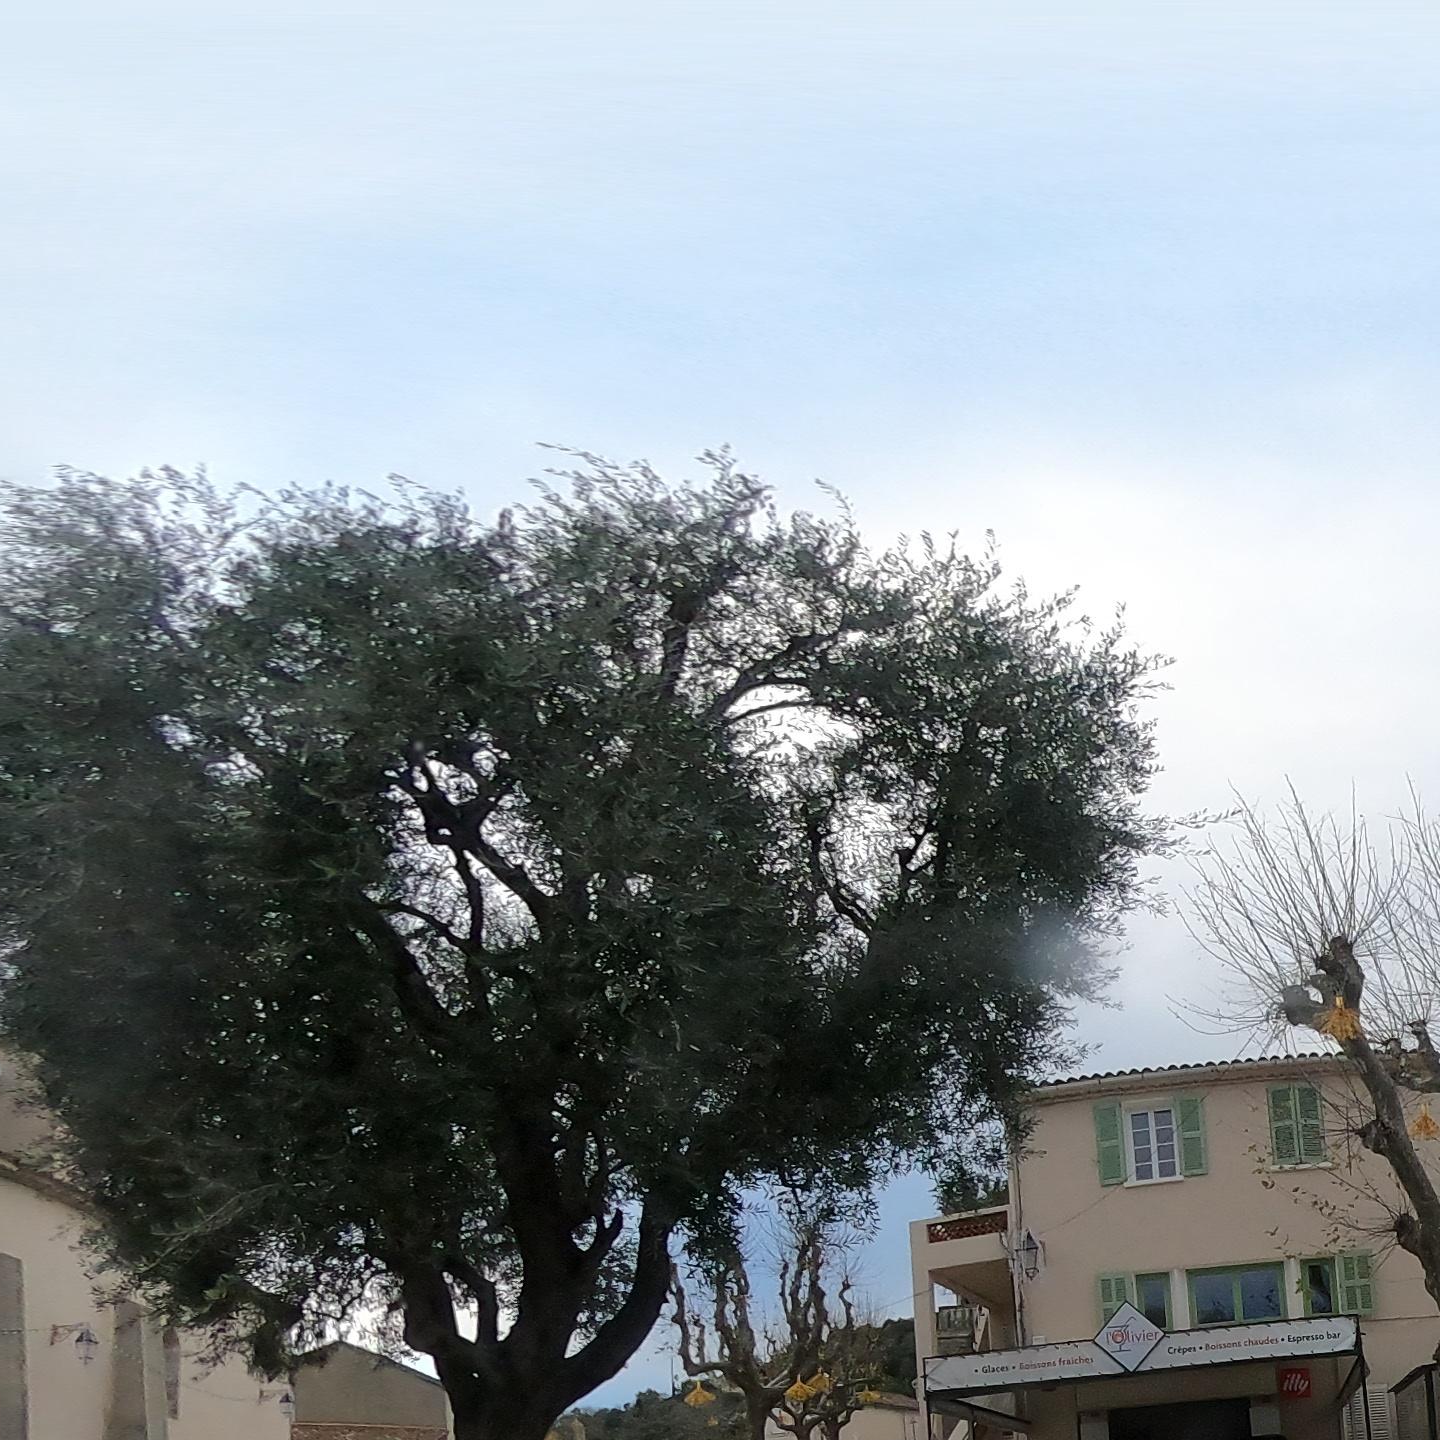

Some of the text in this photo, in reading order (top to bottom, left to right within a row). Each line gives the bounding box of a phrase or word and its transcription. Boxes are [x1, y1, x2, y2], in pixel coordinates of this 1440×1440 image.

[1205, 1340, 1242, 1351] Boissons
[1243, 1338, 1279, 1347] chaudes
[1287, 1333, 1325, 1344] Espresso
[1327, 1331, 1341, 1340] bar
[982, 1364, 1009, 1374] Glaces
[1019, 1360, 1056, 1370] Boissons
[1284, 1373, 1309, 1392] illy
